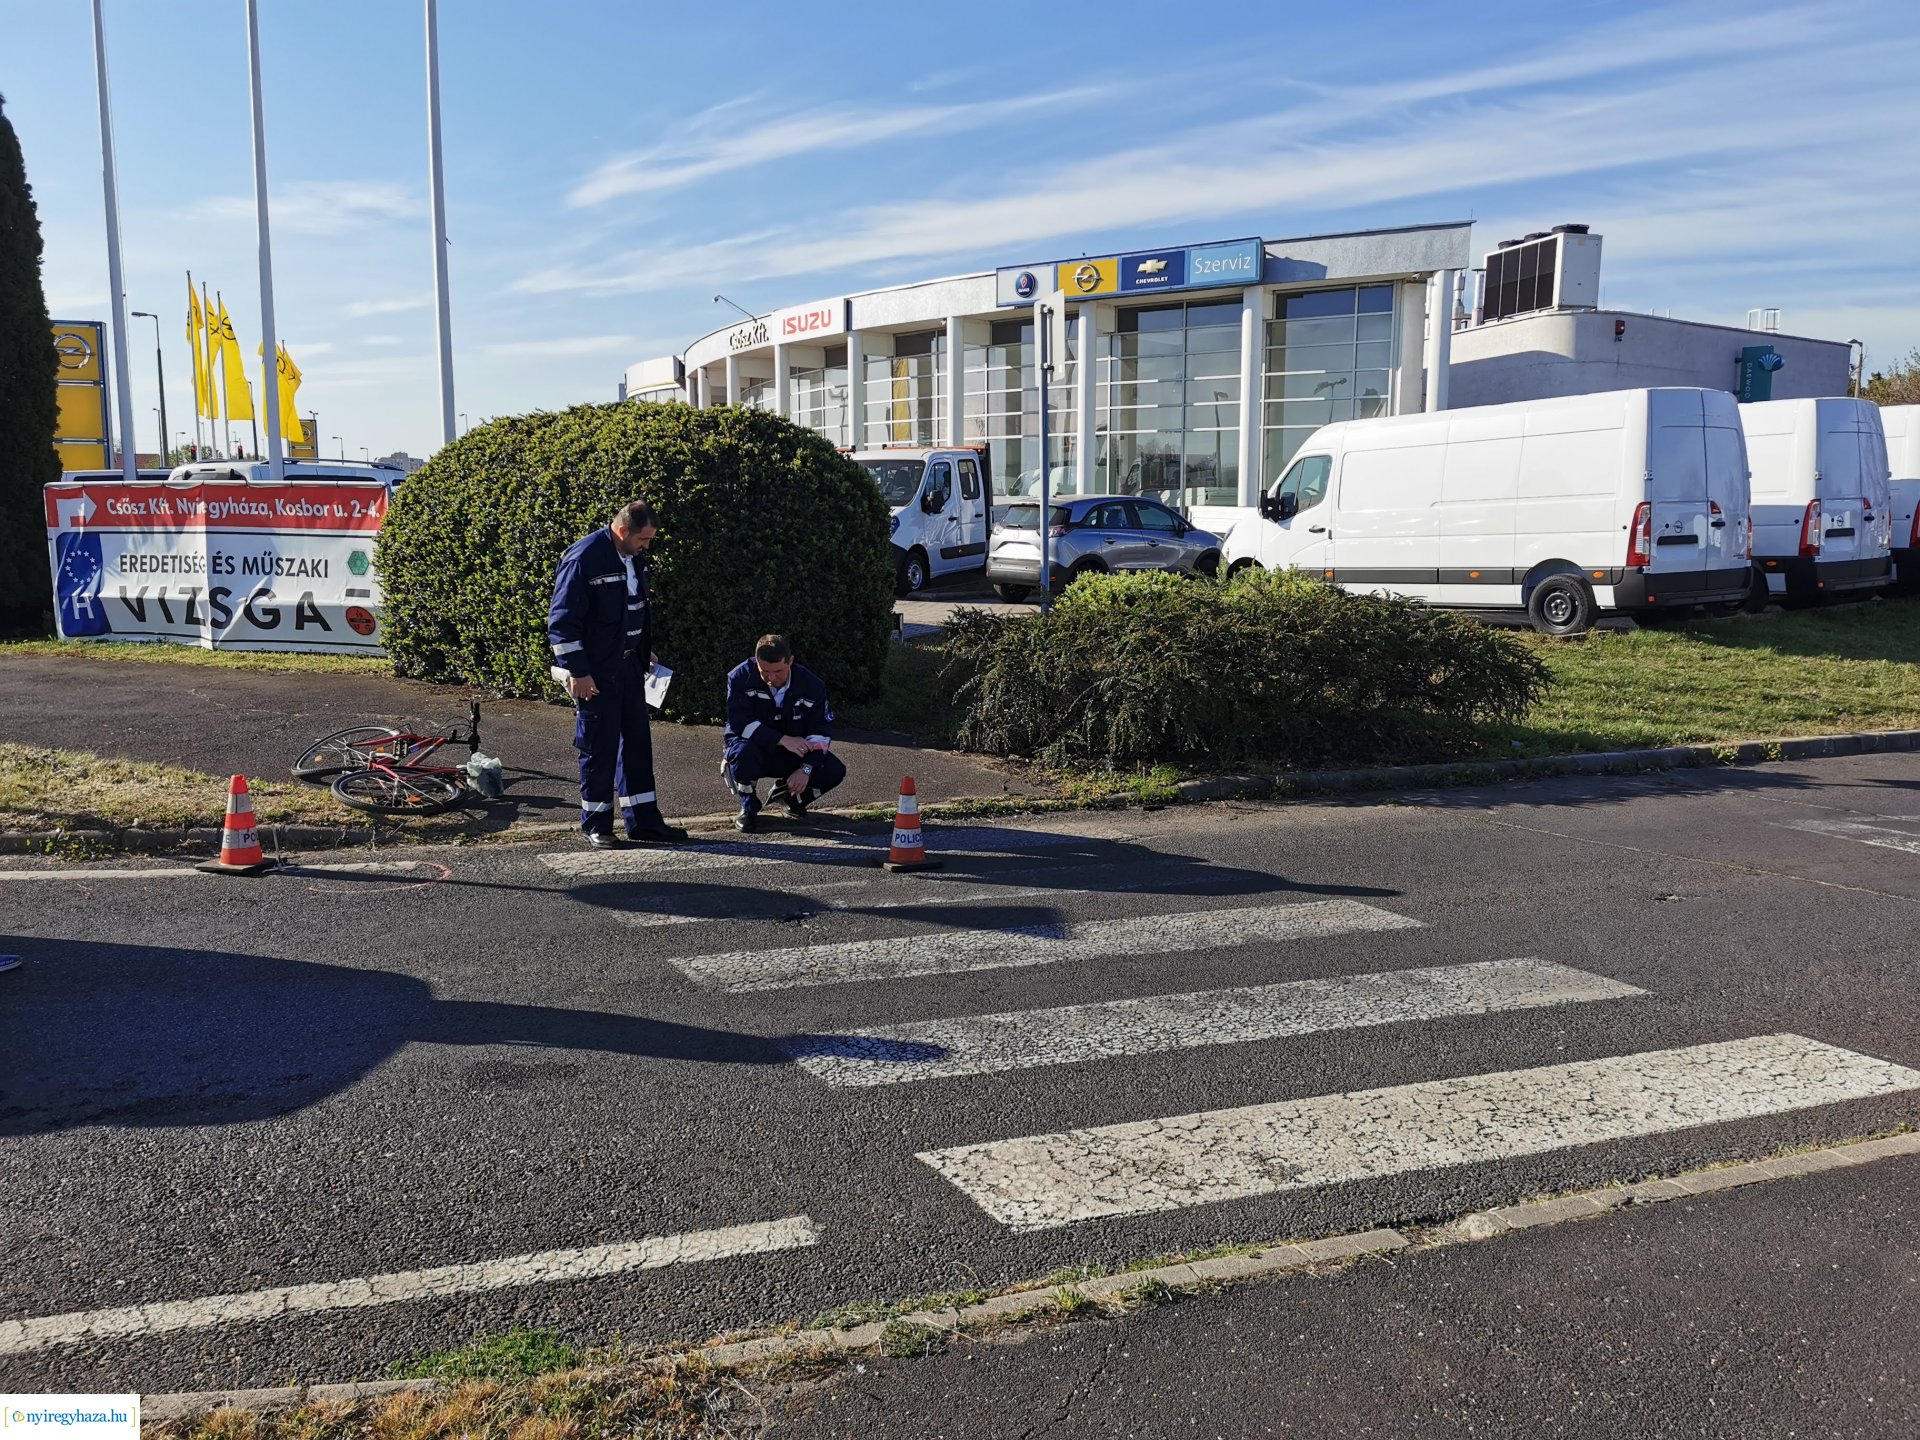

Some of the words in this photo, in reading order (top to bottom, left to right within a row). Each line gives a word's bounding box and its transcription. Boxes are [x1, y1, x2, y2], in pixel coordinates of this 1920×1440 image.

[1194, 252, 1251, 275] Szerviz
[782, 308, 832, 336] ISUZU
[106, 497, 147, 515] Csősz
[148, 497, 174, 515] Kft.
[275, 498, 329, 517] Kosbor
[332, 504, 348, 517] u.
[350, 499, 380, 518] 2-4.
[119, 550, 206, 574] EREDETISÉG
[211, 550, 236, 575] ÉS
[242, 551, 329, 578] MŰSZAKI
[71, 584, 95, 620] H
[118, 585, 333, 632] VIZSGA
[894, 832, 922, 844] POLIC
